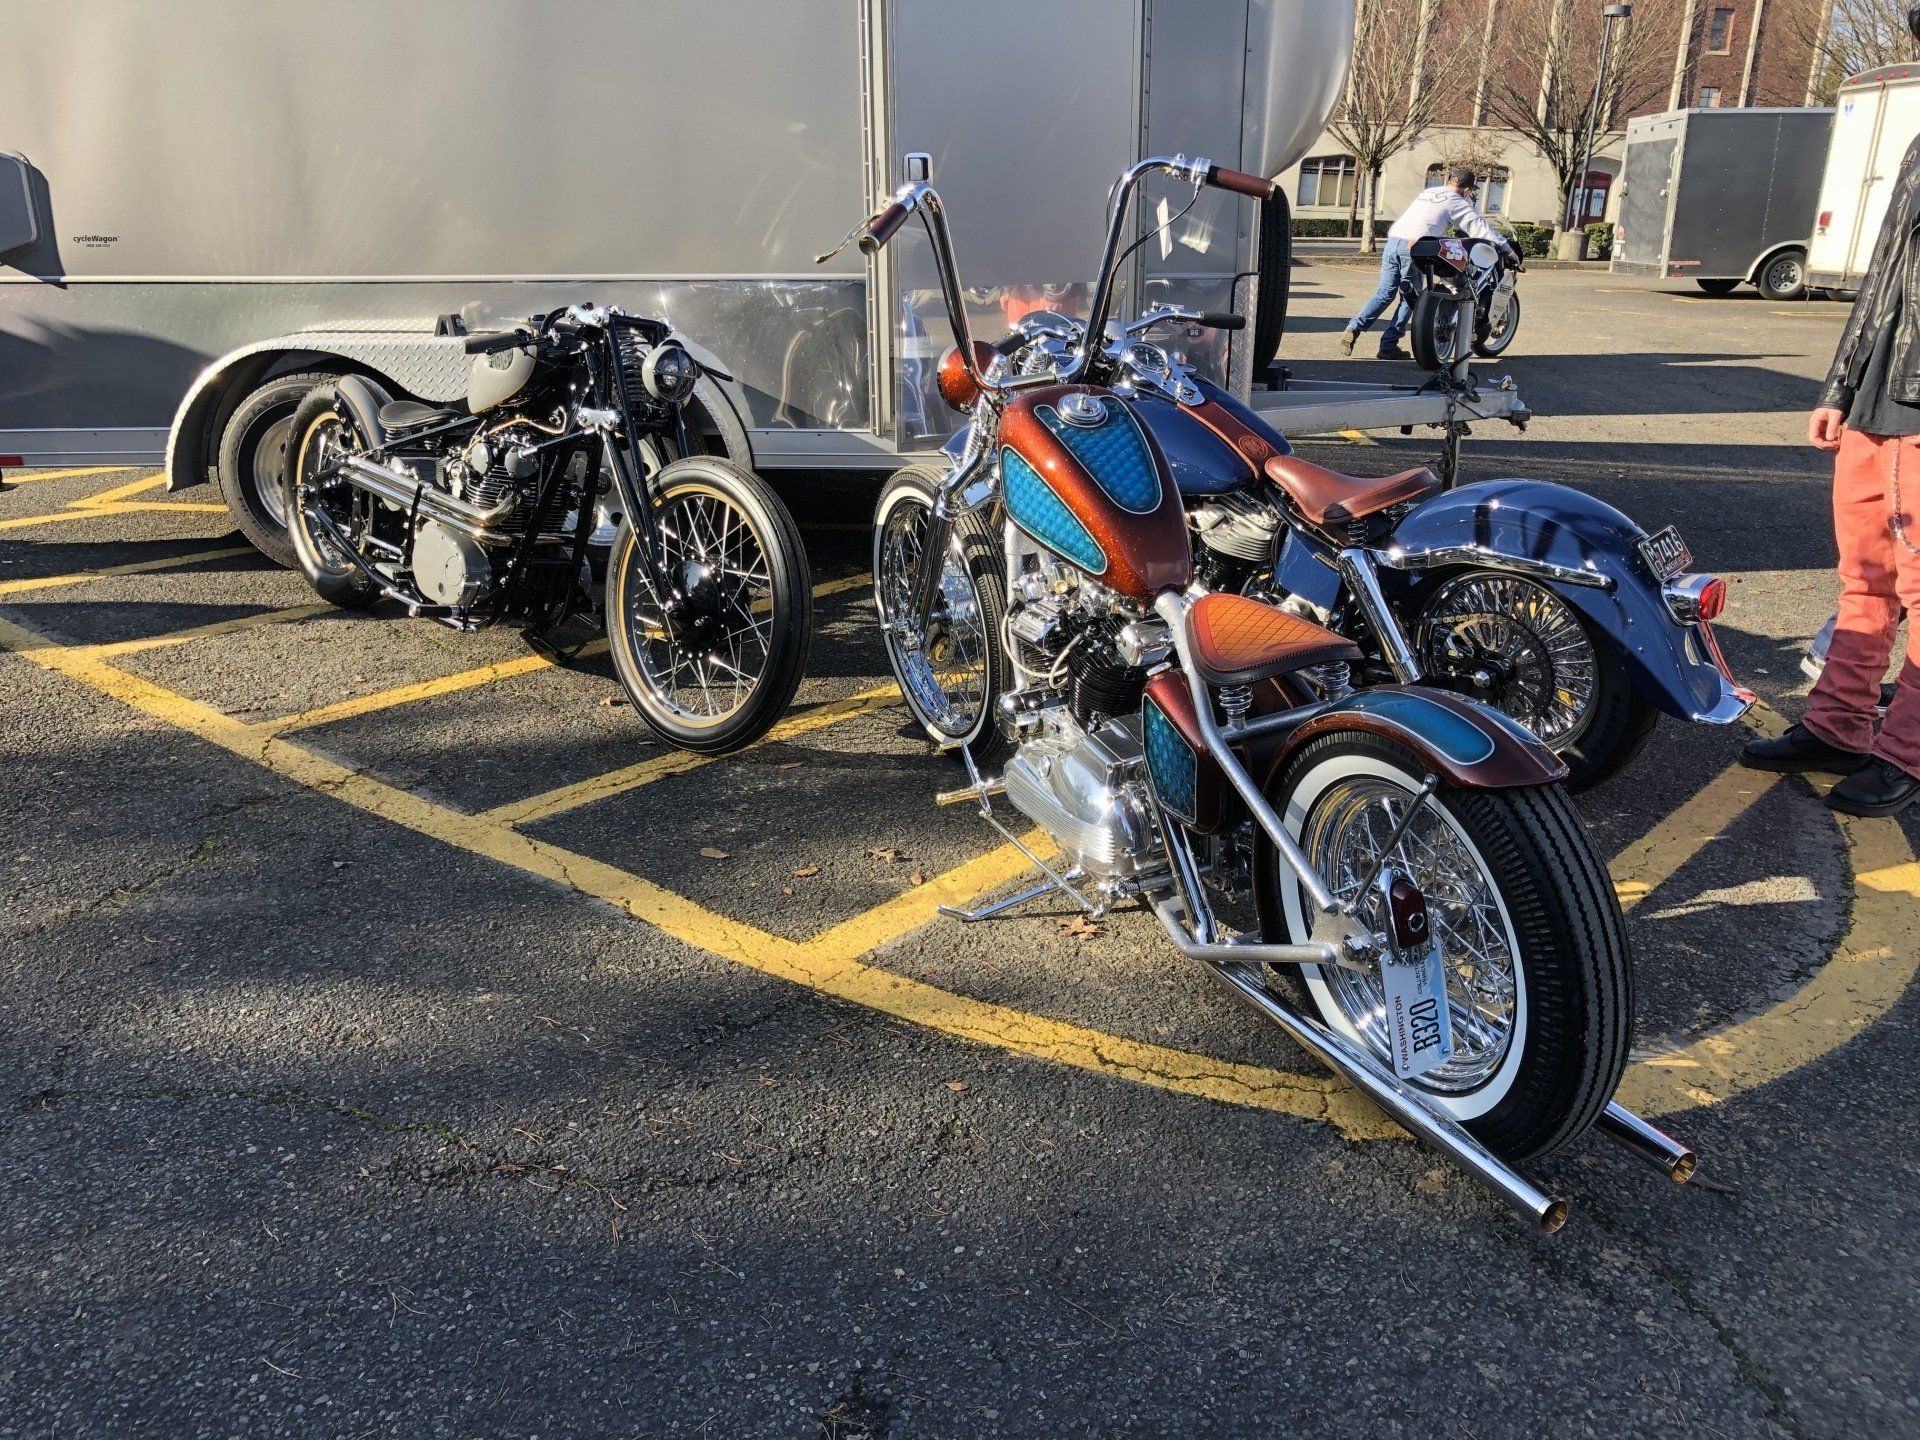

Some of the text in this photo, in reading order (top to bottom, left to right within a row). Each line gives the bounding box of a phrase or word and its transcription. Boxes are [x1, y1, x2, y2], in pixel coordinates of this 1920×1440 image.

[72, 234, 118, 244] cycleWagon
[1653, 532, 1684, 563] 7416
[1394, 995, 1409, 1062] WASHINGTON
[1409, 997, 1441, 1054] B320
